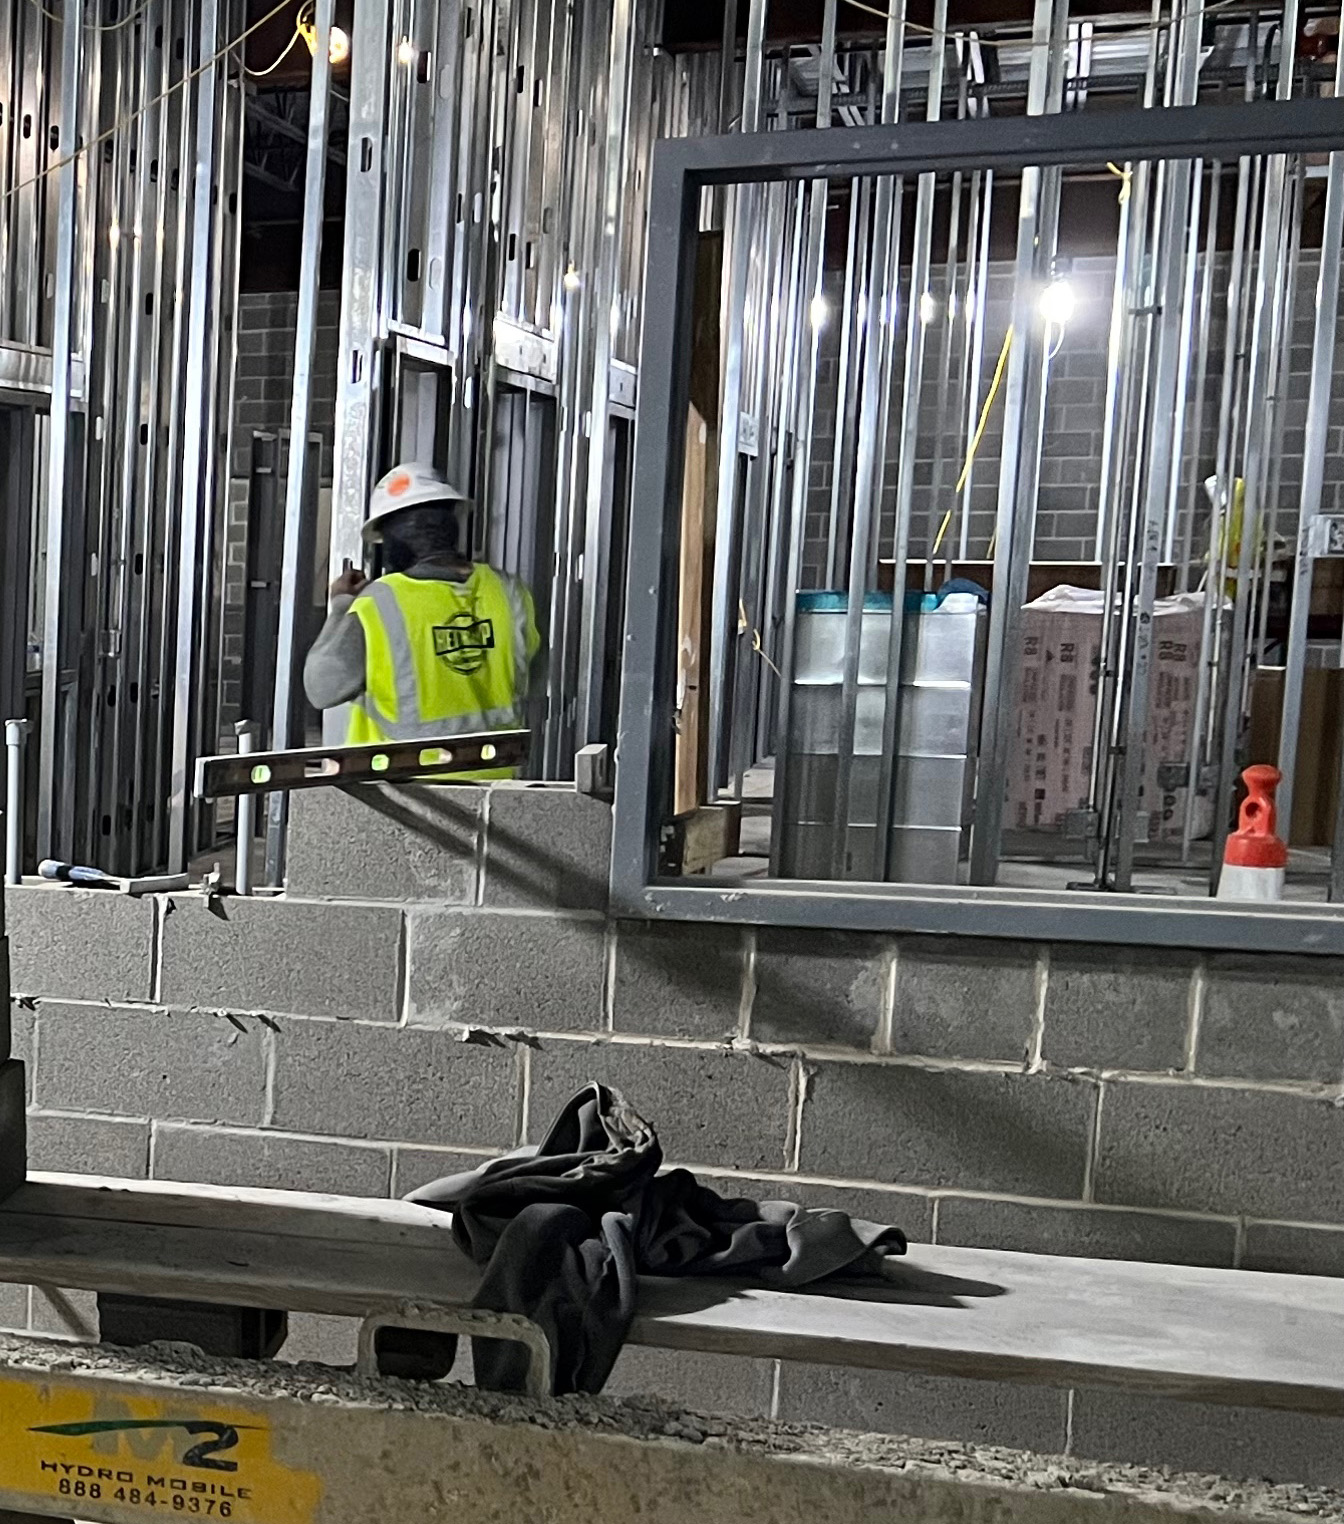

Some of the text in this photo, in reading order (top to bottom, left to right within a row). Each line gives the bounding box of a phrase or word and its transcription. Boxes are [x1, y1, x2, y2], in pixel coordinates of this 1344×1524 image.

[40, 1459, 253, 1500] HYDRO MOBILE
[58, 1478, 233, 1518] 888 484-9376
